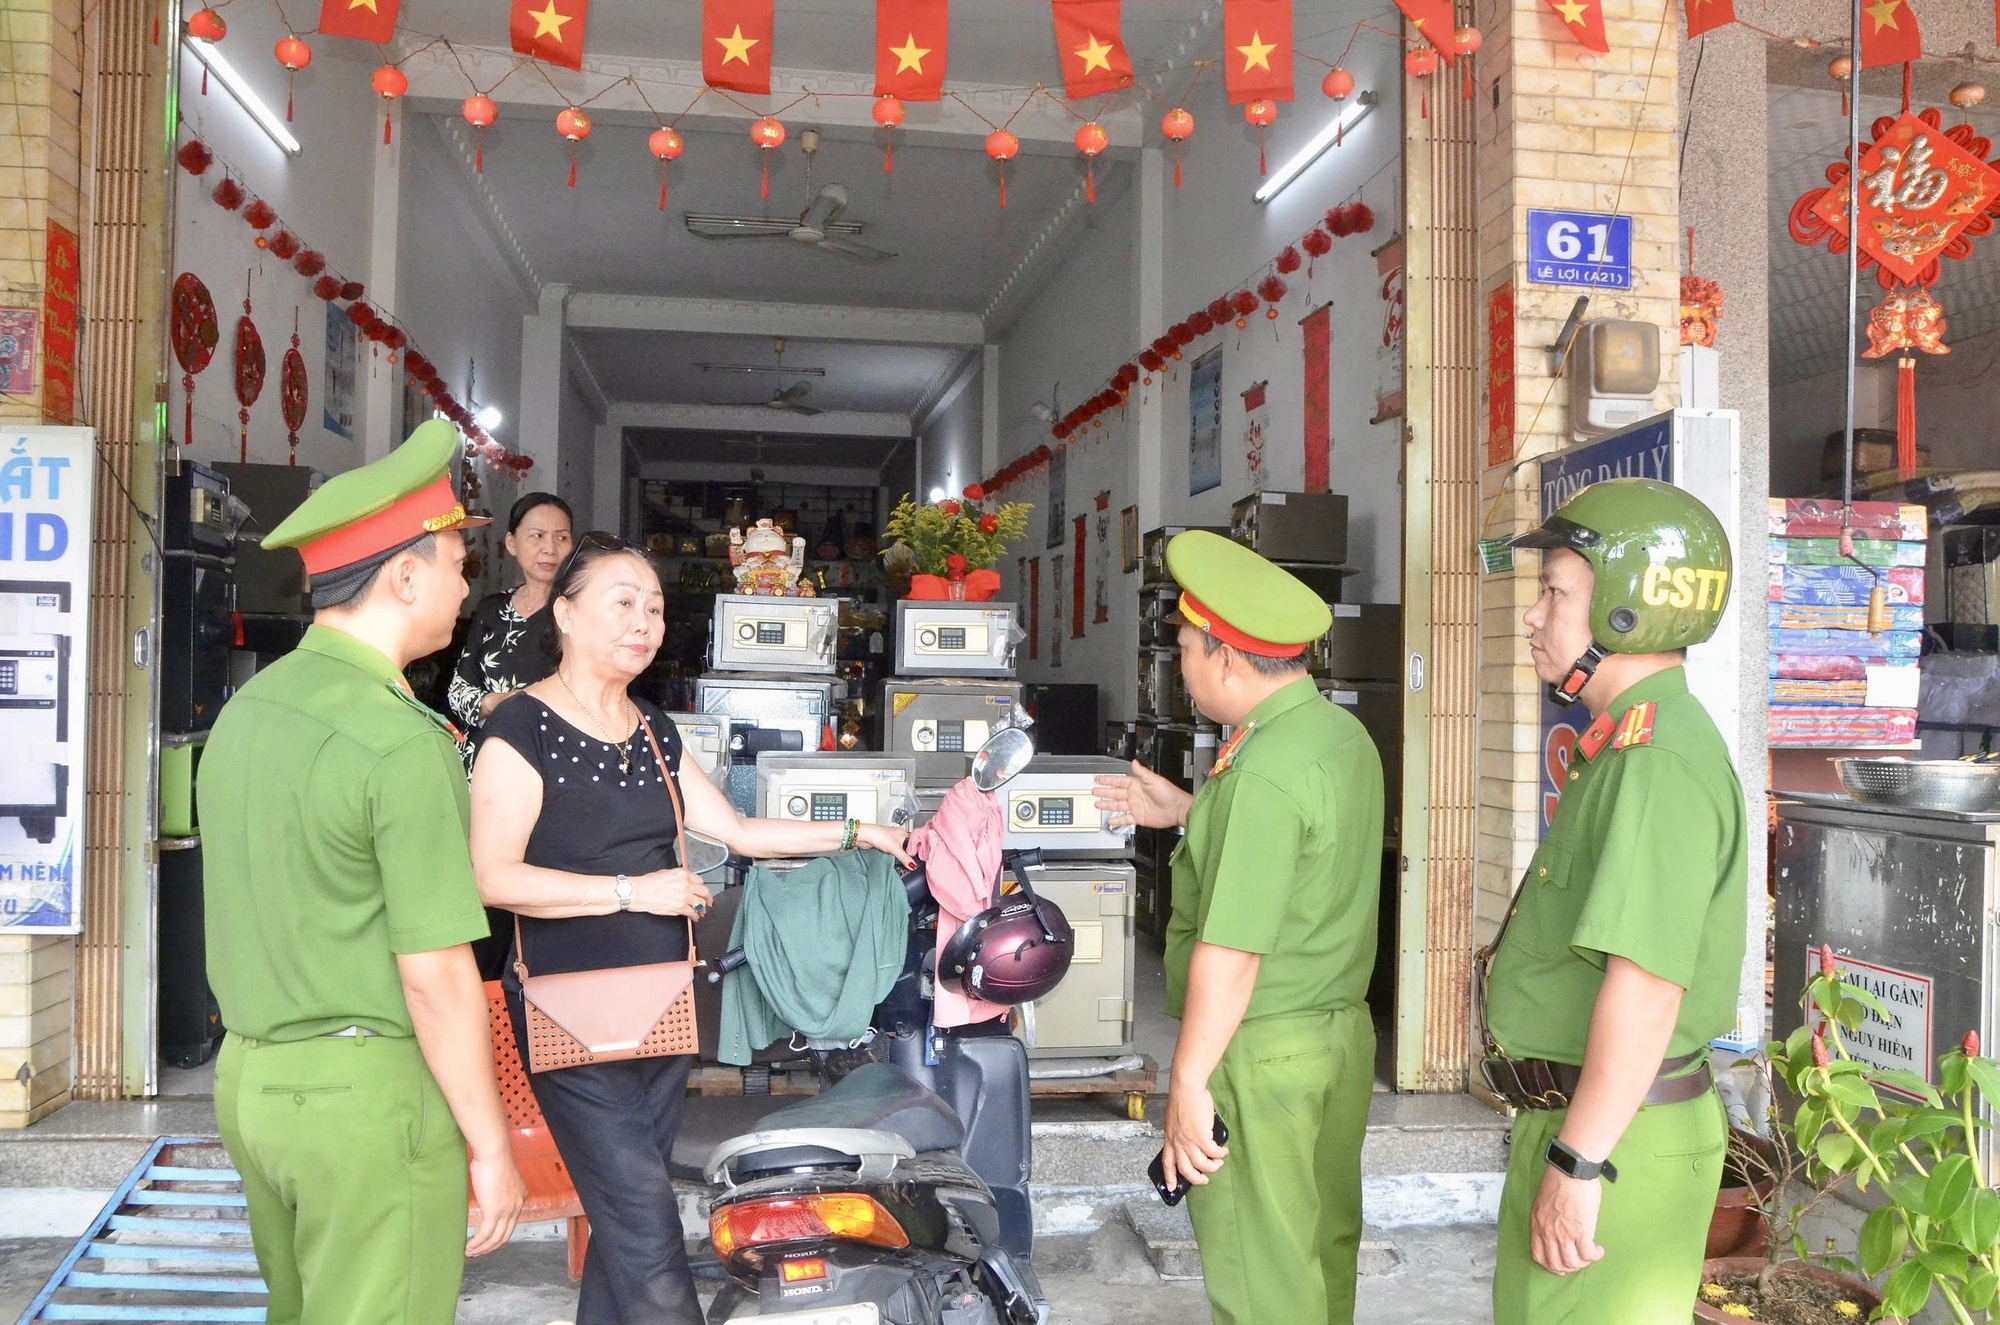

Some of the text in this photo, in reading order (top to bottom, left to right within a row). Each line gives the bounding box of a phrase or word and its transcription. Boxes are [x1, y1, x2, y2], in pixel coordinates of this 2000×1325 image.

[1863, 135, 1948, 214] 福
[1547, 221, 1613, 262] 61
[1538, 265, 1623, 284] LÊ LỢI (A21)
[1643, 564, 1728, 612] CSTT
[21, 861, 61, 881] NÊN
[1889, 982, 1924, 1008] GẦN!
[1840, 1025, 1875, 1048] NGUY
[784, 1285, 831, 1297] HOND
